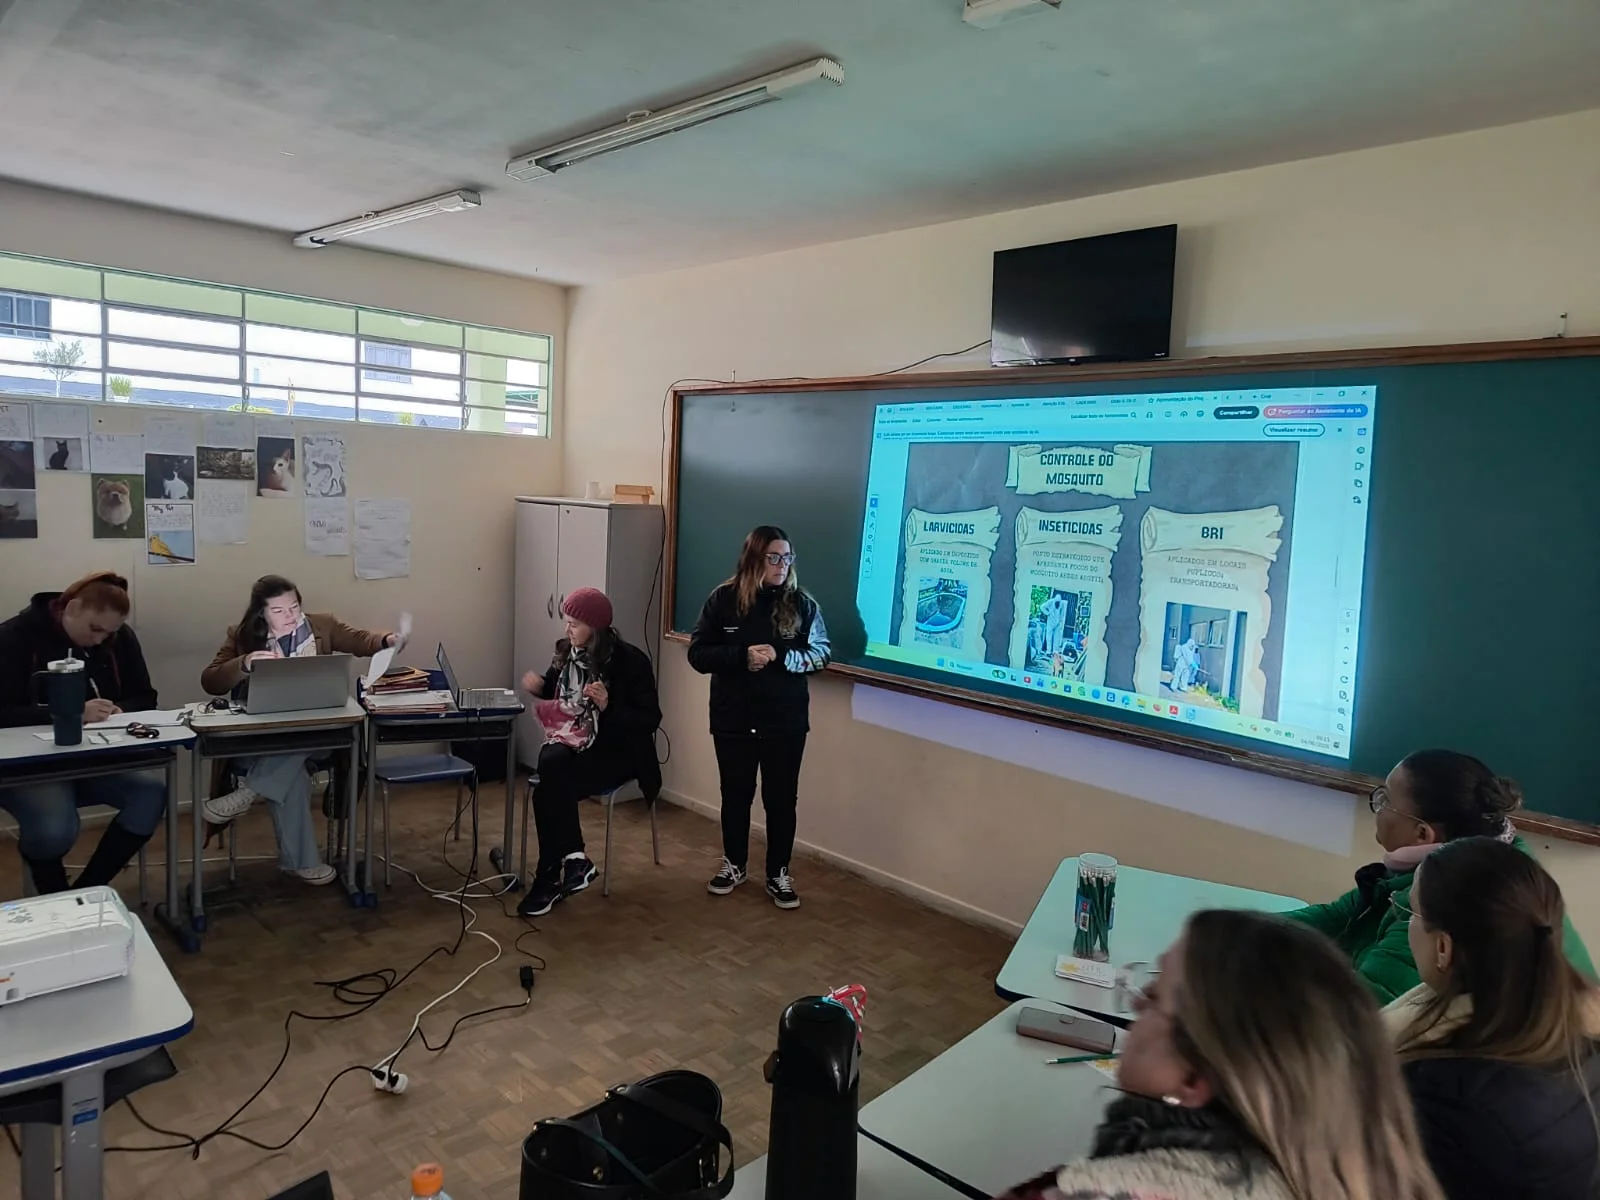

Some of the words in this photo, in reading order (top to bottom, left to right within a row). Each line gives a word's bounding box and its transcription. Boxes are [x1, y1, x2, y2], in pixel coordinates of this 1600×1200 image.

[1277, 408, 1306, 416] Perguntar
[1040, 453, 1095, 466] CONTROLE
[1098, 454, 1114, 466] DO
[1046, 472, 1104, 486] MOSQUITO
[923, 520, 975, 536] LARVICIDAS
[1038, 519, 1104, 536] INSETICIDAS
[1201, 526, 1224, 540] BRI
